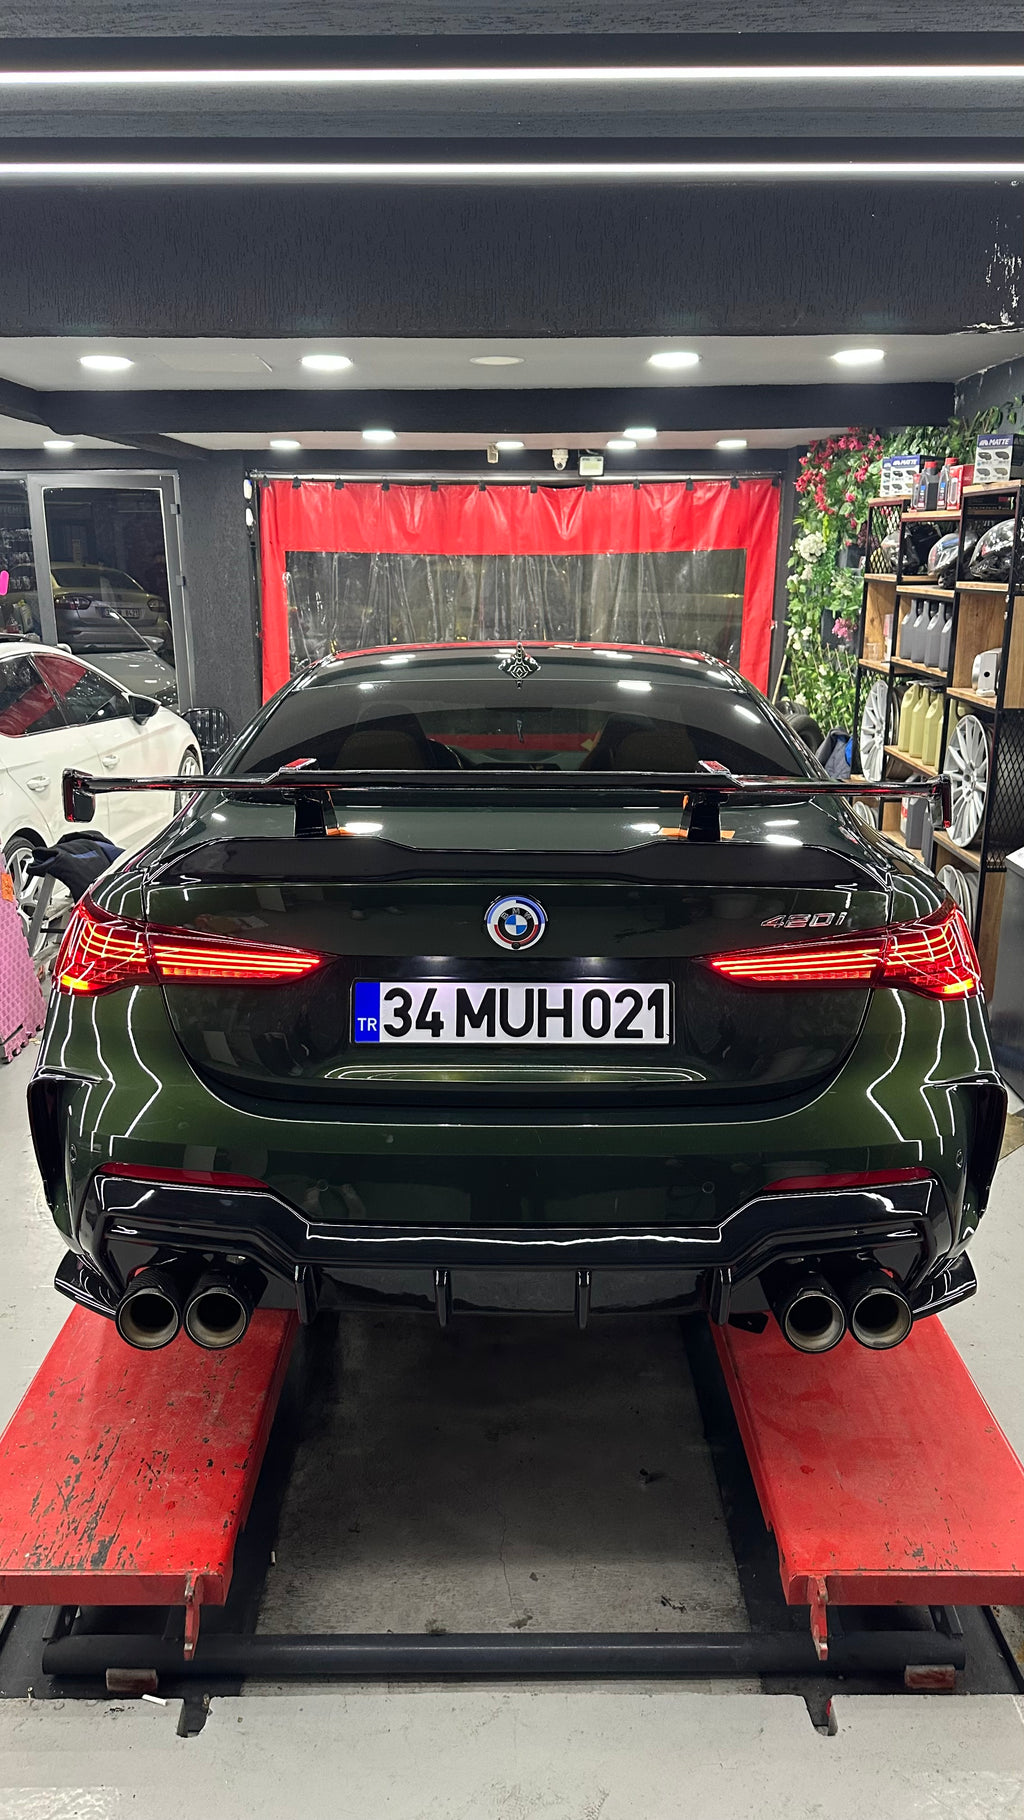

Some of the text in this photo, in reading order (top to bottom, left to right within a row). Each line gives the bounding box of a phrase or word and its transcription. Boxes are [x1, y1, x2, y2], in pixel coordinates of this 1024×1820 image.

[989, 438, 1011, 446] MATTE
[500, 907, 532, 920] BMW
[760, 911, 848, 929] 420i
[383, 987, 665, 1039] 34 MUH 021
[357, 1017, 377, 1031] TR
